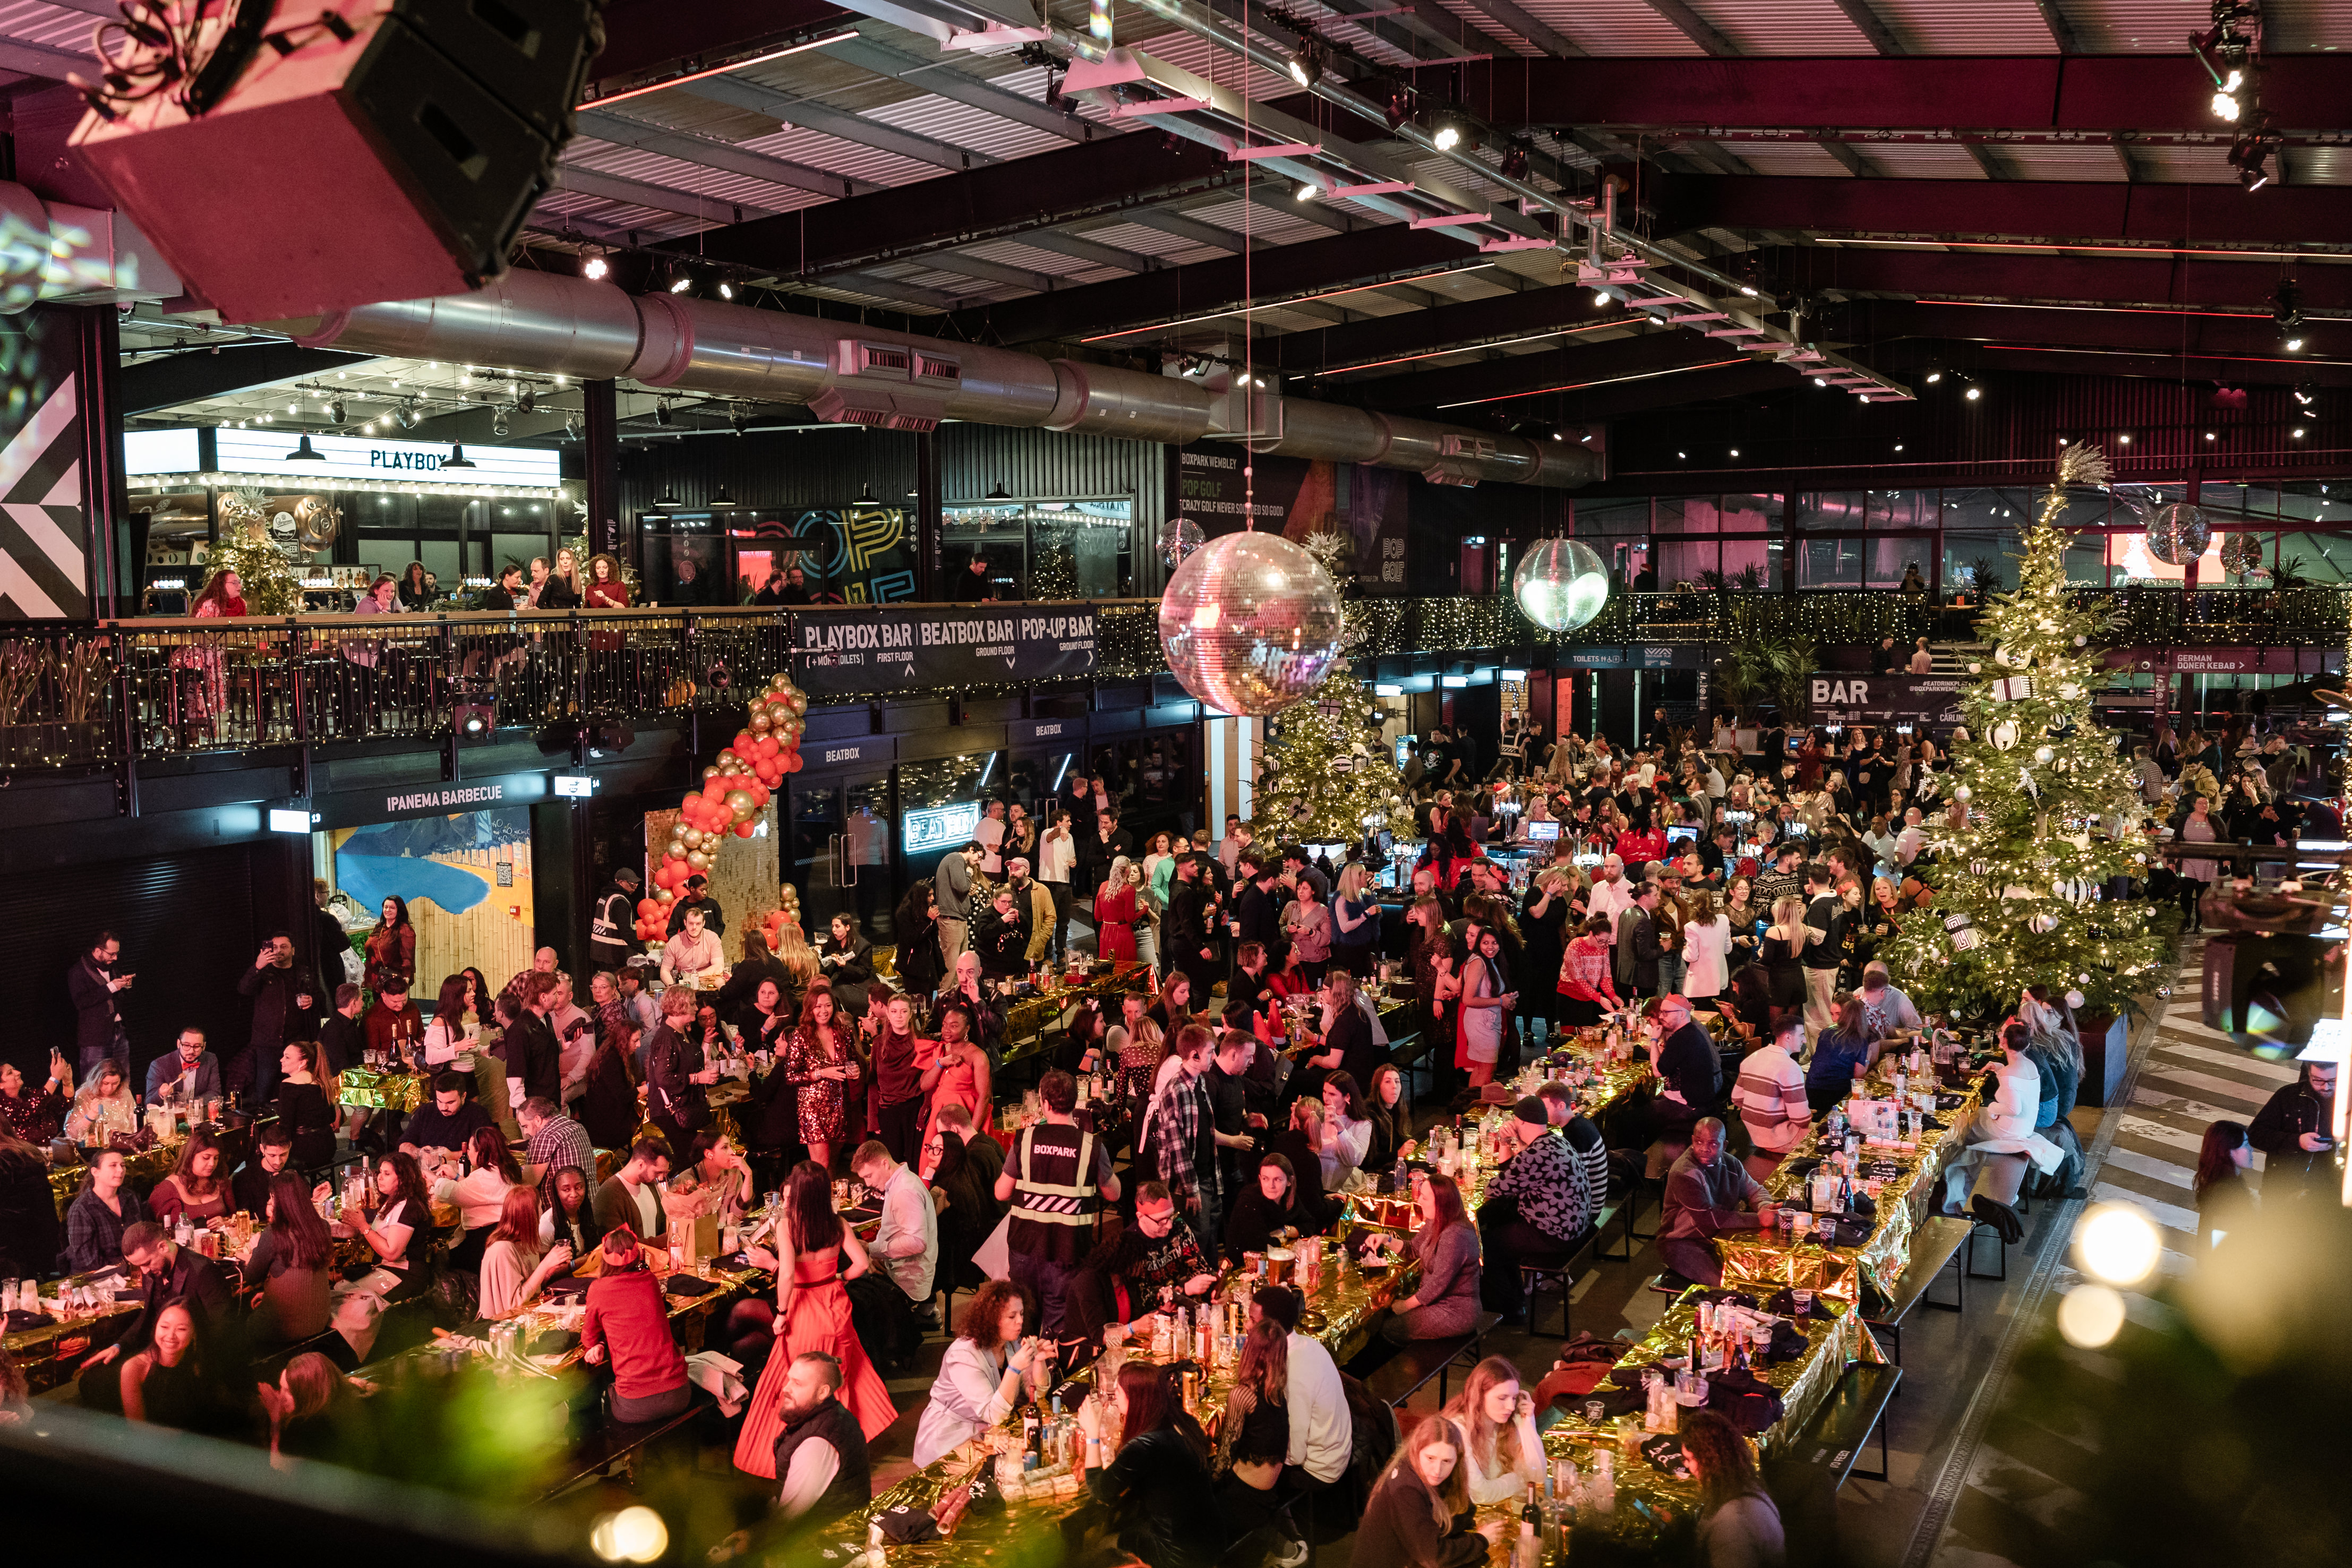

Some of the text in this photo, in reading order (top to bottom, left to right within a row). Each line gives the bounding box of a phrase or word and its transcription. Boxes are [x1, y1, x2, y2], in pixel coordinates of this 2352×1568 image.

[371, 450, 447, 472] PLAYBOX
[1182, 453, 1237, 470] BOXPARK WEMBLEY
[1182, 479, 1221, 498] POP GOLF
[1182, 499, 1201, 511] CRAZY
[1201, 500, 1216, 512] GOLF
[1217, 501, 1235, 514] NEVER
[1262, 505, 1269, 516] SO
[1270, 505, 1284, 517] GOOD
[1383, 538, 1405, 559] POP
[1382, 561, 1405, 582] GOLF
[805, 615, 1094, 649] PLAYBOX BAR BEATBOX BAR POP-UP BAR
[976, 645, 1015, 657] GROUND FLOOR
[1059, 640, 1094, 651] GROUND FLOOR
[877, 651, 914, 663] FIRST FLOOR
[1812, 680, 1868, 704] BAR
[1939, 714, 1967, 722] CARLING
[1036, 723, 1062, 736] BEATBOX
[826, 747, 860, 762] BEATBOX
[387, 785, 502, 811] IPANEMA BARBECUE
[311, 813, 321, 823] 13
[910, 816, 944, 843] BEAT
[1033, 1144, 1077, 1158] BOXPARK
